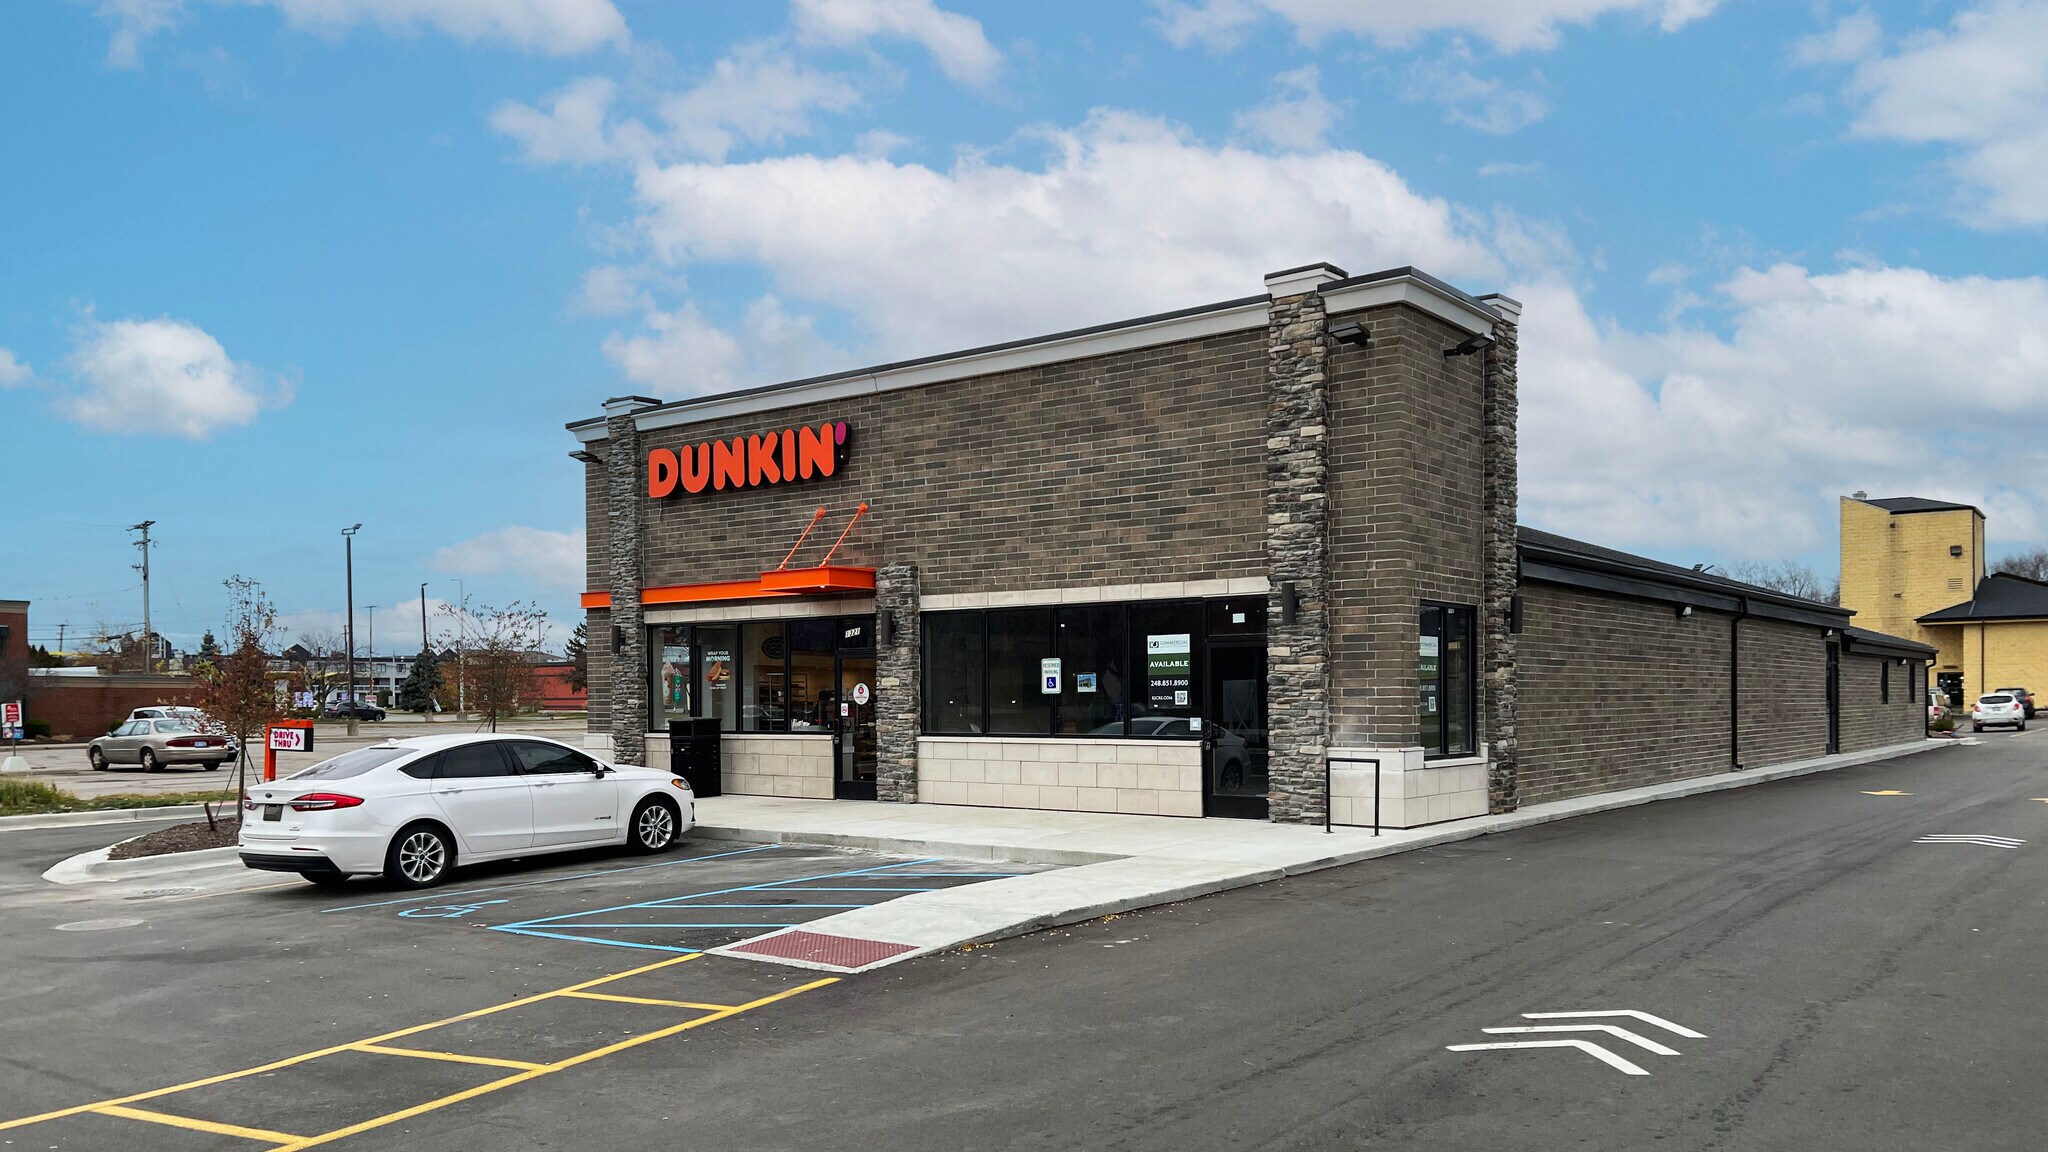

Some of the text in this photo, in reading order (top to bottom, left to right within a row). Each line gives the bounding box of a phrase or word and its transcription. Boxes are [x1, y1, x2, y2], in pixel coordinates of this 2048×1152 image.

[648, 421, 847, 498] DUNKIN'
[844, 627, 861, 638] 1321
[1150, 679, 1189, 687] 248.851.8900
[273, 731, 294, 739] DRIVE
[274, 740, 292, 748] THRU
